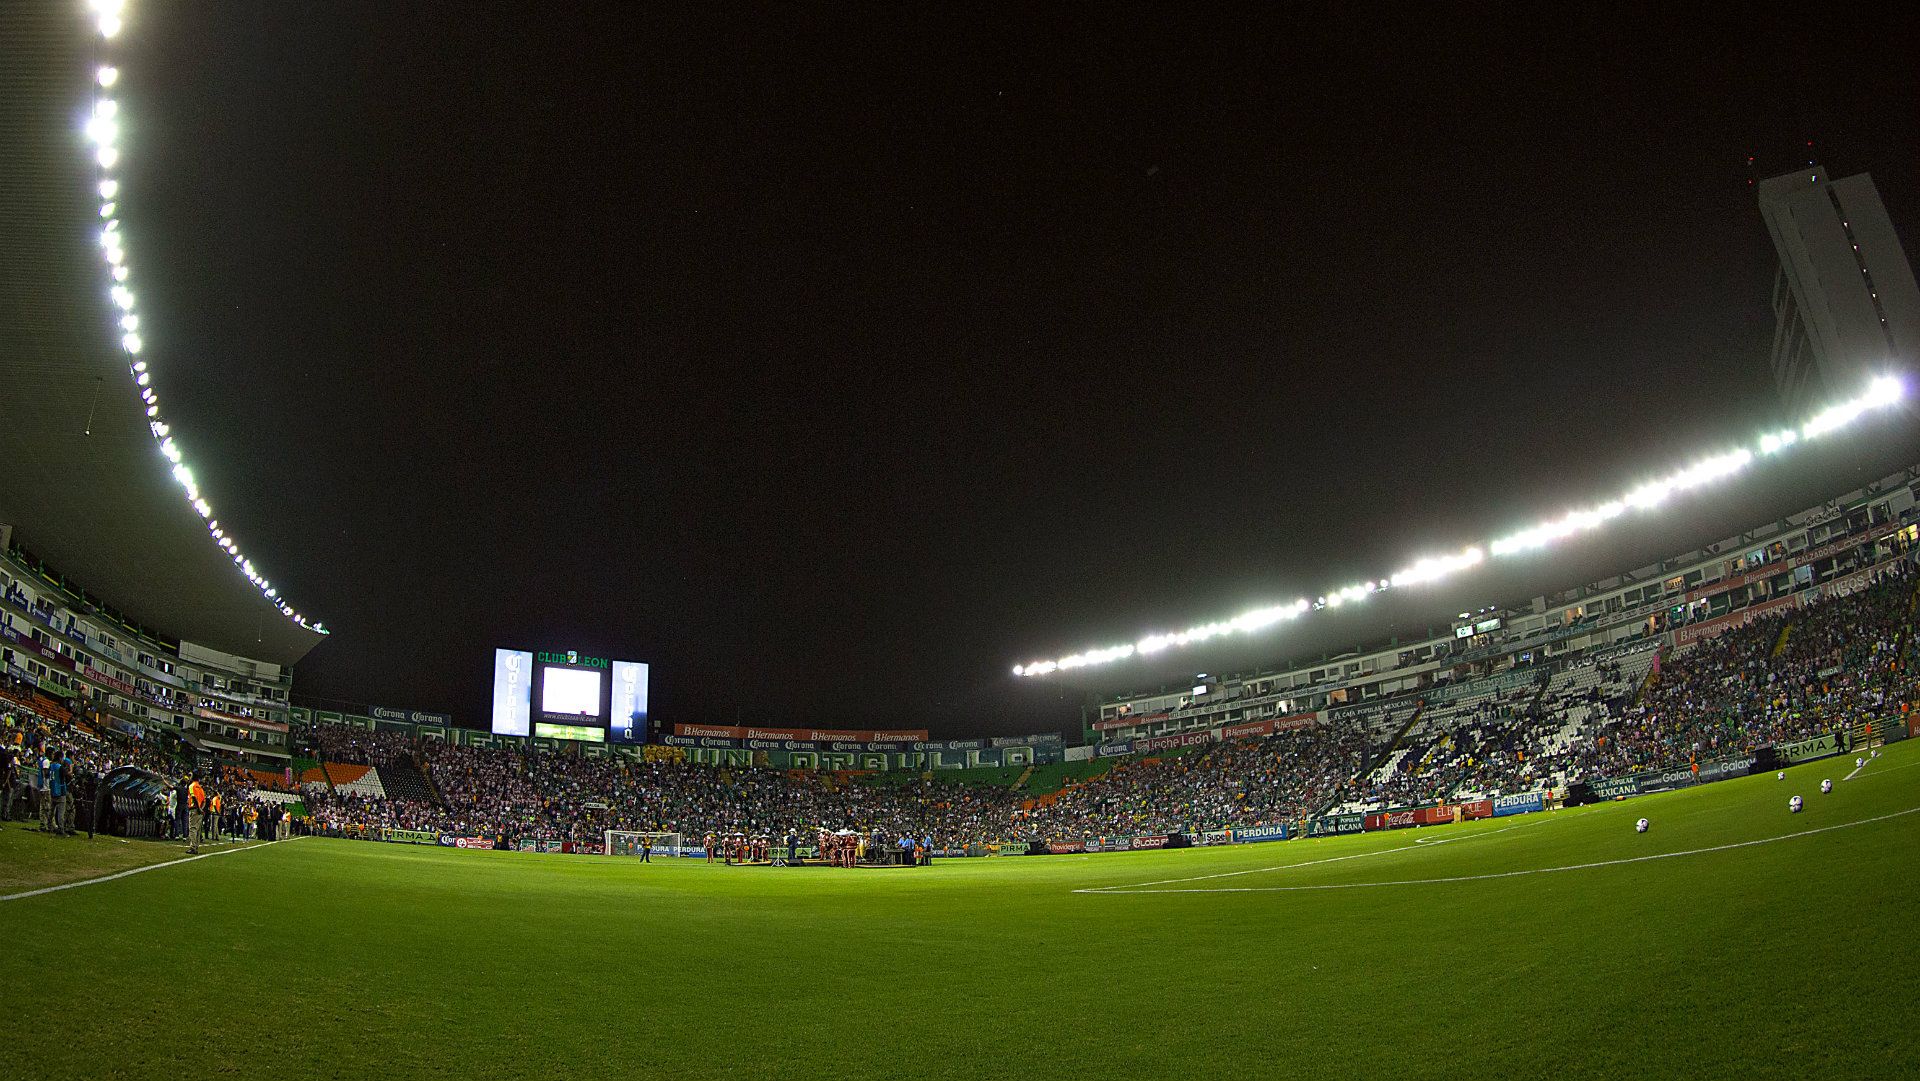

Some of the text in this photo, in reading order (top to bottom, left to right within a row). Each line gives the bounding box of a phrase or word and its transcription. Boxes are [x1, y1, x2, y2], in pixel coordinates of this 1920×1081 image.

[537, 651, 609, 669] CLUB LEON
[373, 707, 406, 719] Corona
[411, 711, 444, 725] Corona
[664, 735, 696, 746] Corona
[700, 736, 732, 748] Corona
[749, 739, 780, 750] Corona
[784, 740, 815, 751] Corona
[832, 741, 862, 752] Corona
[913, 740, 944, 752] Corona
[948, 739, 979, 751] Corona
[867, 742, 898, 752] Corona
[1099, 744, 1128, 757] Corona
[1494, 793, 1540, 808] PERDURA
[1436, 807, 1447, 818] EL
[1236, 827, 1283, 839] PERDURA
[1000, 844, 1030, 853] PIRMA
